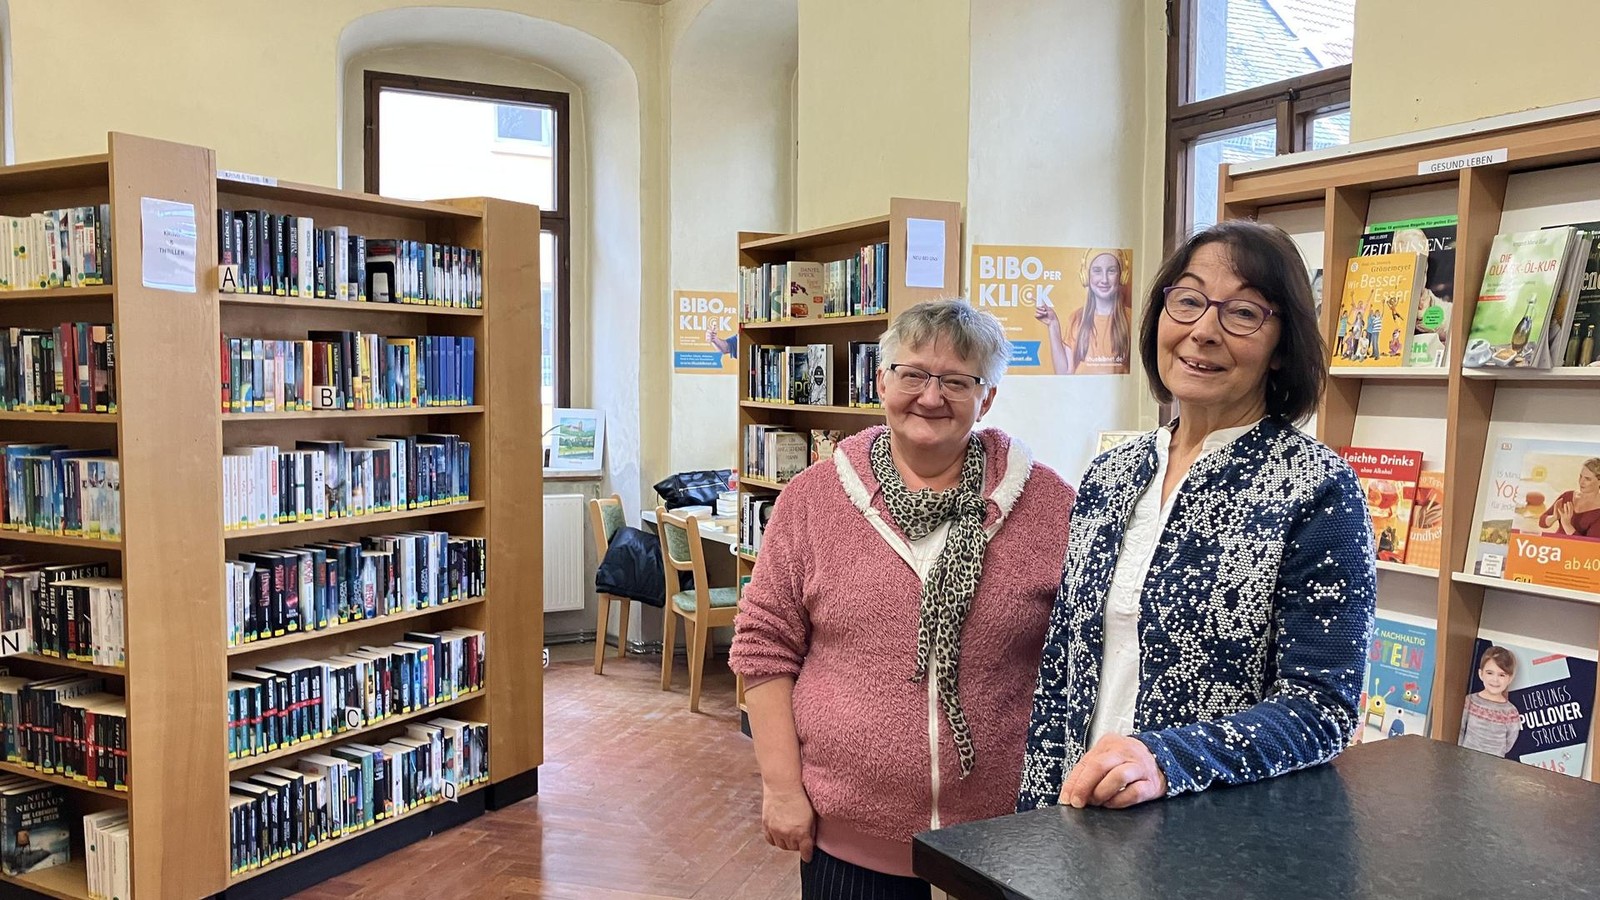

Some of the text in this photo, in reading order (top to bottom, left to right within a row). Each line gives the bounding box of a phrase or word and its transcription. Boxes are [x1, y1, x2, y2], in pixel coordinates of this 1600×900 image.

[1430, 155, 1493, 172] GESUND LEBEN
[1362, 237, 1445, 257] ZEIT WISSEN
[980, 255, 1062, 280] BIBO PER
[1500, 254, 1512, 263] DIE
[222, 266, 236, 288] A
[1370, 264, 1412, 273] Grönemeyer
[1360, 274, 1407, 288] Besser-
[1374, 288, 1409, 303] Esser
[680, 297, 724, 314] BIBO
[106, 333, 114, 368] Mankell
[321, 388, 334, 407] B
[1344, 452, 1414, 467] Leichte Drinks
[1374, 467, 1392, 475] Alkohol
[1504, 471, 1520, 479] Minu
[1495, 479, 1519, 504] Yog
[1516, 538, 1562, 564] Yoga
[1564, 556, 1600, 572] ab 40
[54, 572, 66, 582] JO
[1, 632, 20, 654] N
[1380, 631, 1426, 646] NACHHALTIG
[1522, 685, 1572, 710] LIEBLINGS
[347, 710, 359, 728] C
[1520, 702, 1583, 732] PULLOVER
[1532, 723, 1578, 747] STRICKEN
[28, 790, 52, 802] NELE
[445, 781, 455, 800] D
[16, 796, 64, 814] NEUHAUS
